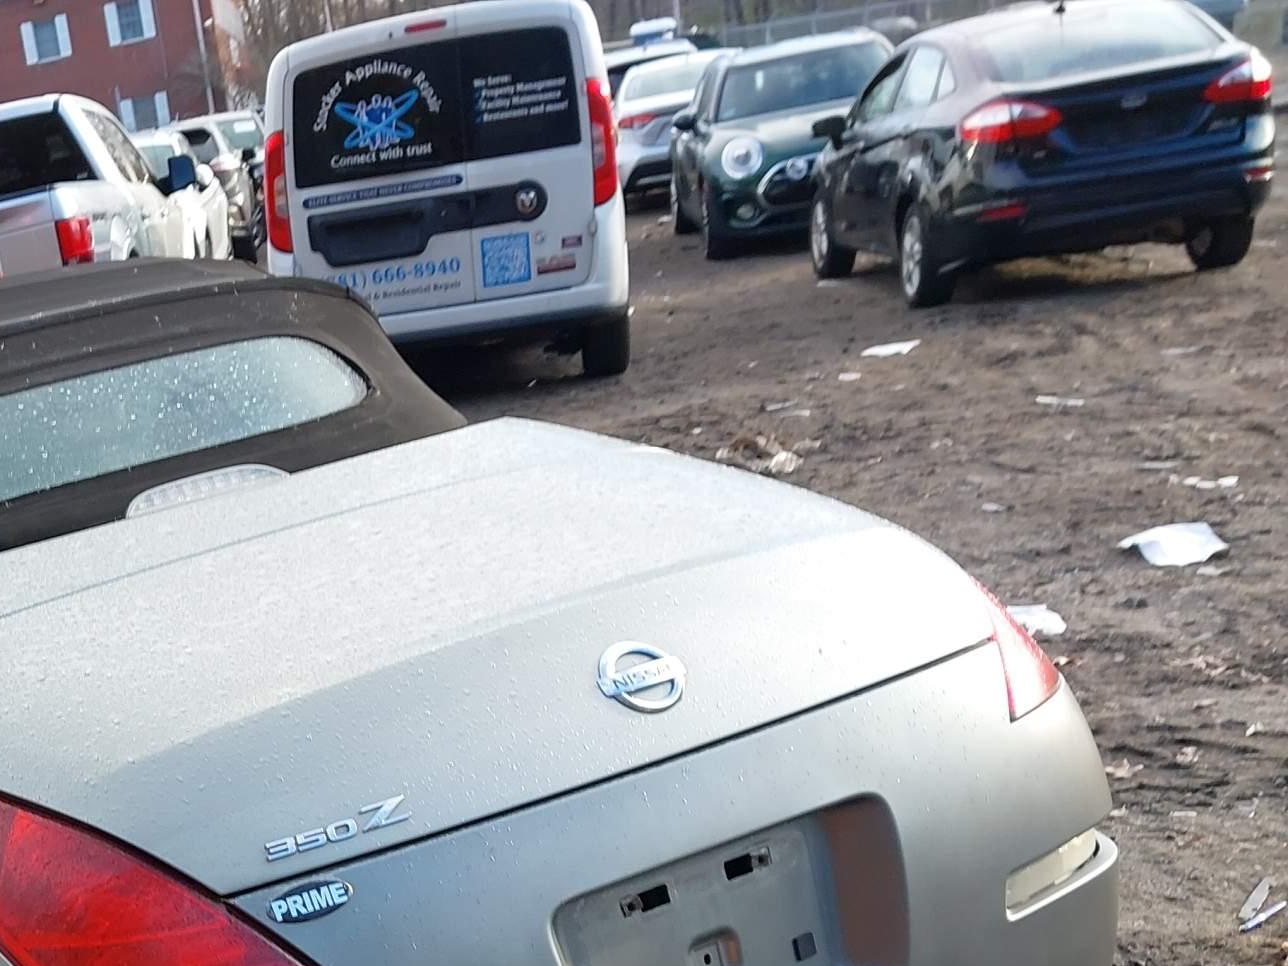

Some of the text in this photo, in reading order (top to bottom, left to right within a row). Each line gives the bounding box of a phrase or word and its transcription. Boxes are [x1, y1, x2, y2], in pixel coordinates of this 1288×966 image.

[345, 59, 413, 86] Appliance
[413, 69, 442, 113] Repair
[331, 142, 433, 169] Connect with trust
[372, 256, 461, 286] 666-8940
[270, 882, 349, 923] PRIME
